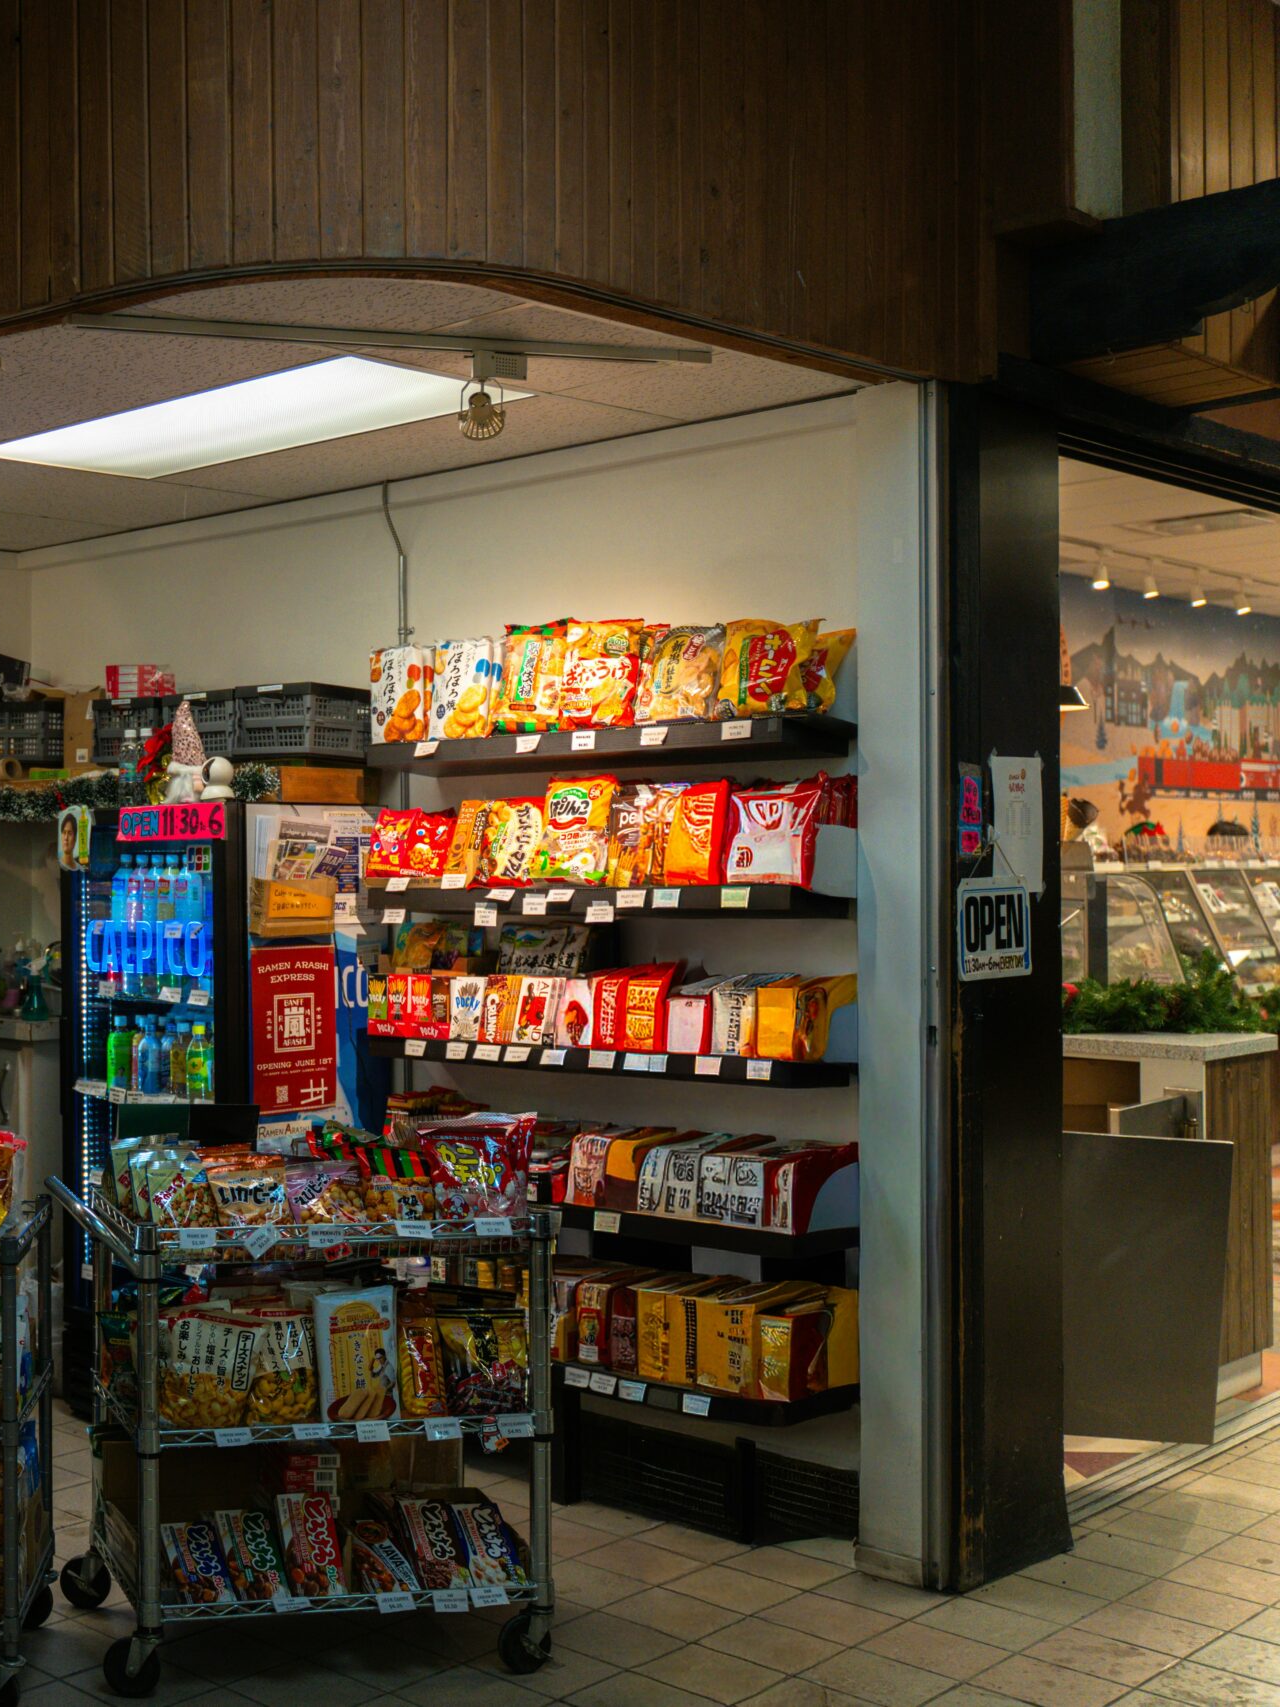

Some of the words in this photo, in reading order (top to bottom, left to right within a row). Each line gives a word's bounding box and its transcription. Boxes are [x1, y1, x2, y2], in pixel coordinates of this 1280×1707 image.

[121, 811, 160, 837] OPEN
[162, 807, 200, 836] 11:30
[208, 804, 223, 836] 6
[965, 894, 1024, 953] OPEN
[85, 919, 207, 977] CALPICO
[257, 961, 291, 975] RAMEN
[294, 960, 329, 971] ARASHI
[270, 973, 316, 984] EXPRESS
[256, 1061, 292, 1071] OPENING
[294, 1058, 316, 1067] JUNE
[258, 1126, 284, 1139] RAMEN
[379, 1542, 404, 1567] JAVA
